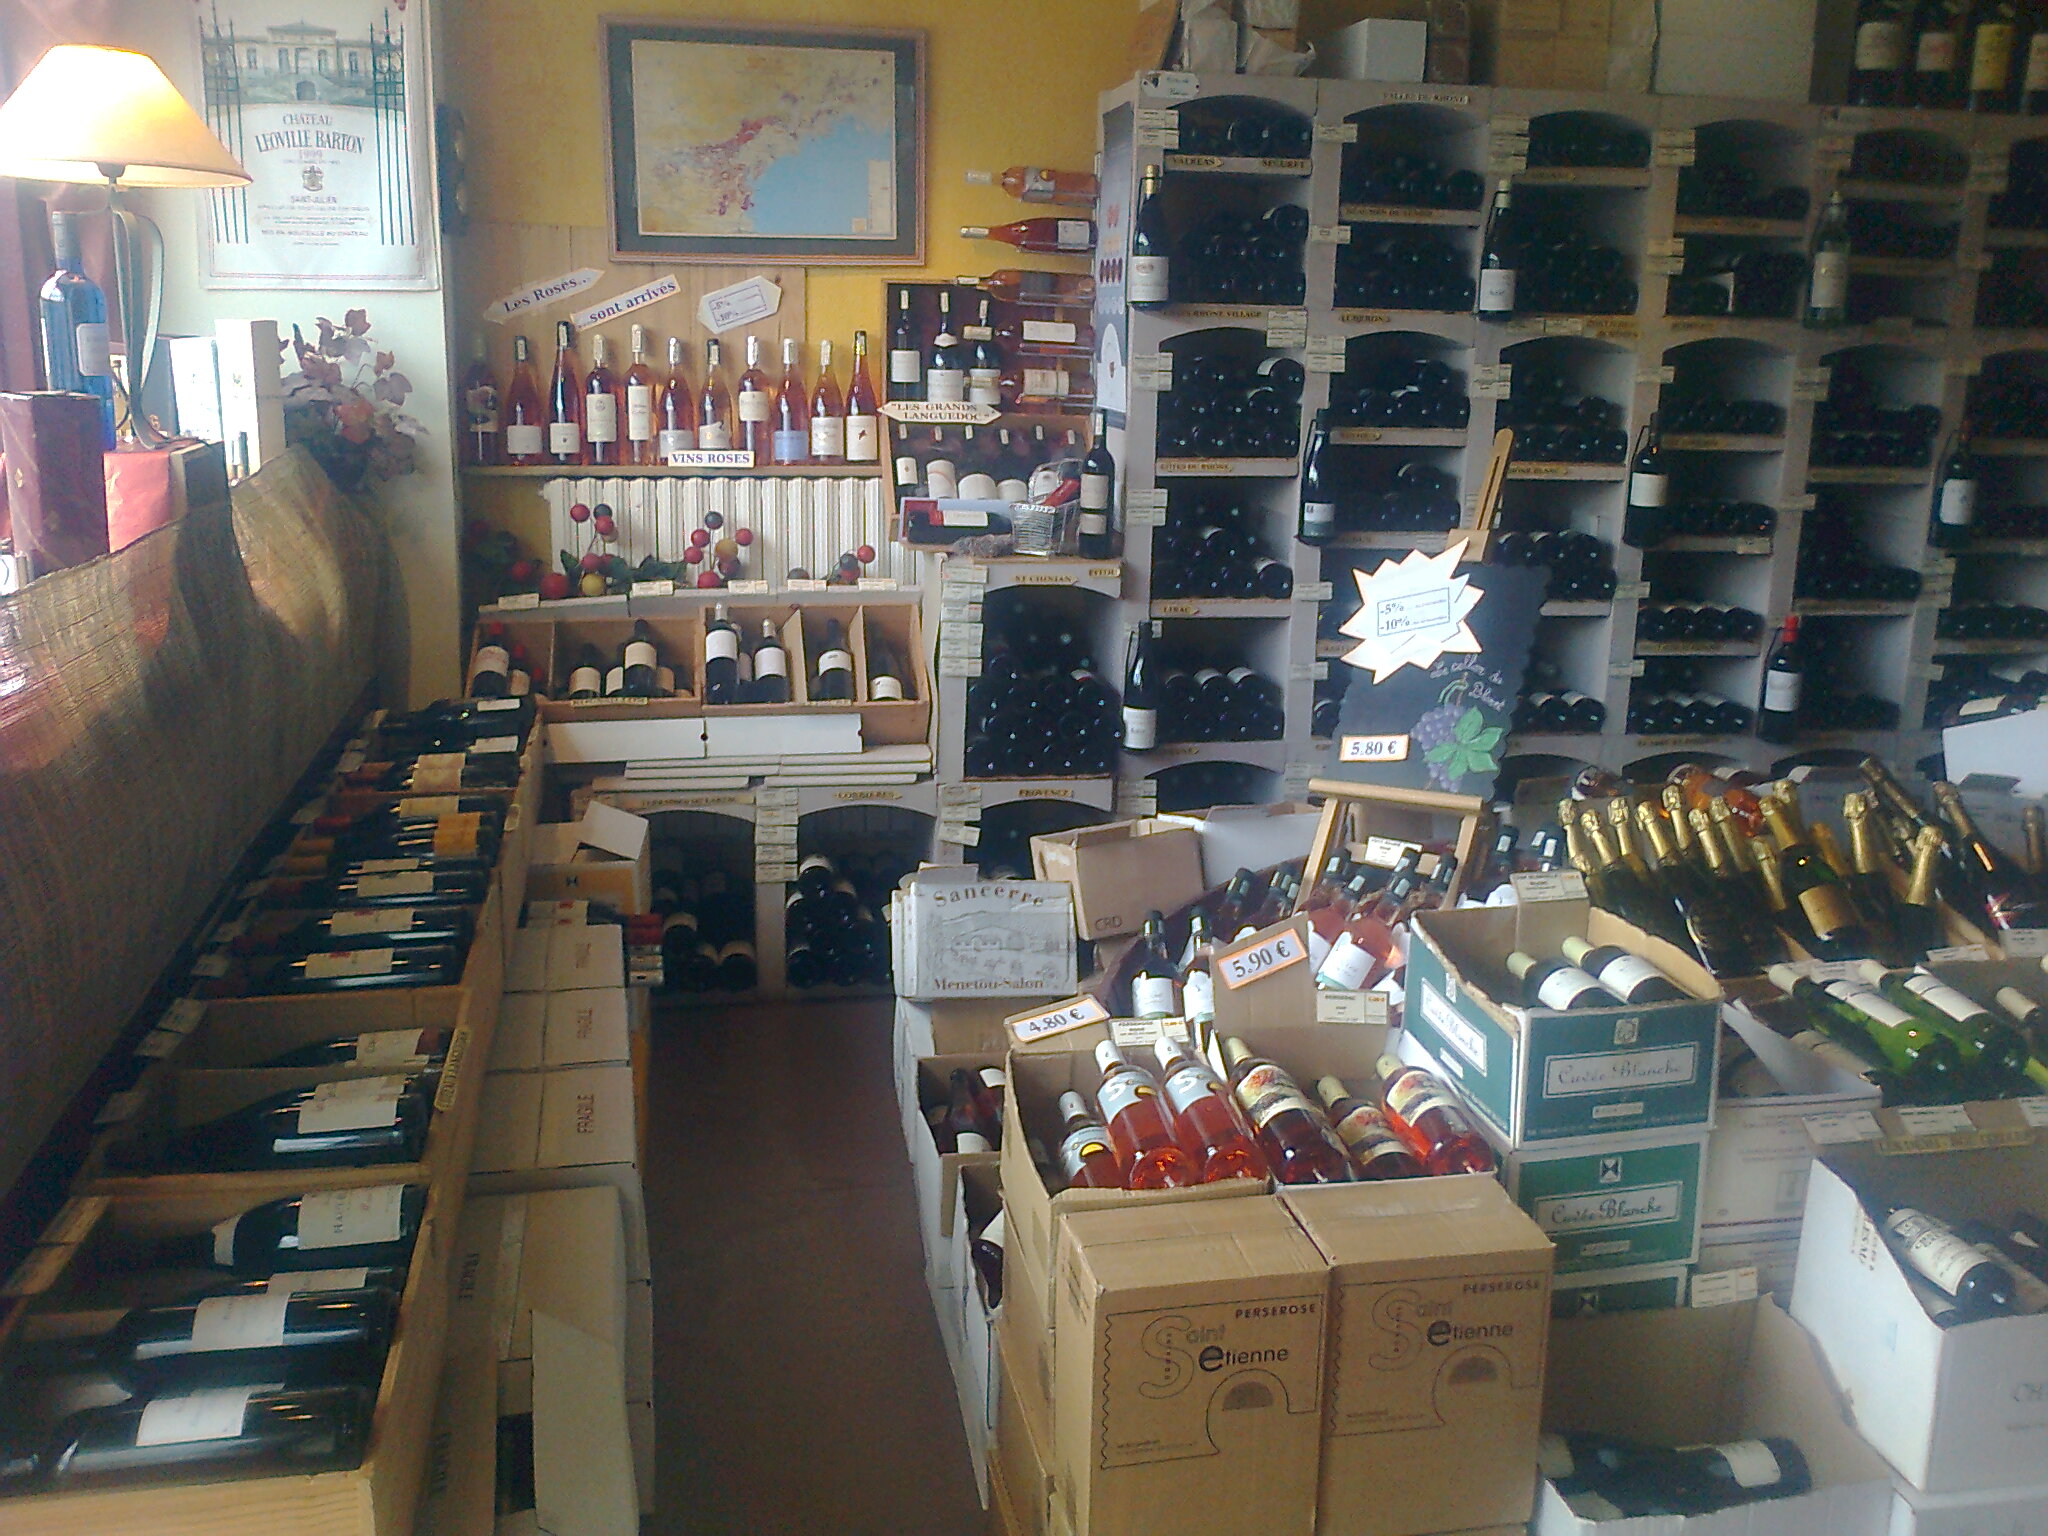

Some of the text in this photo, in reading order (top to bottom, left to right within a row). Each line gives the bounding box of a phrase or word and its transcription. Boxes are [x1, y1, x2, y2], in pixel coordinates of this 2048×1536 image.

[316, 130, 365, 154] BARTON
[504, 297, 531, 313] Les
[925, 404, 977, 412] GRANDS
[672, 454, 703, 463] VINS
[1379, 602, 1405, 616] -5%
[1379, 617, 1410, 632] -10%
[1350, 740, 1398, 756] 5.80 €
[933, 885, 1043, 908] Sancerre
[1232, 940, 1291, 978] 5.90 €
[1029, 1008, 1085, 1033] 4.80 €
[1235, 1303, 1316, 1319] PERSEROSE
